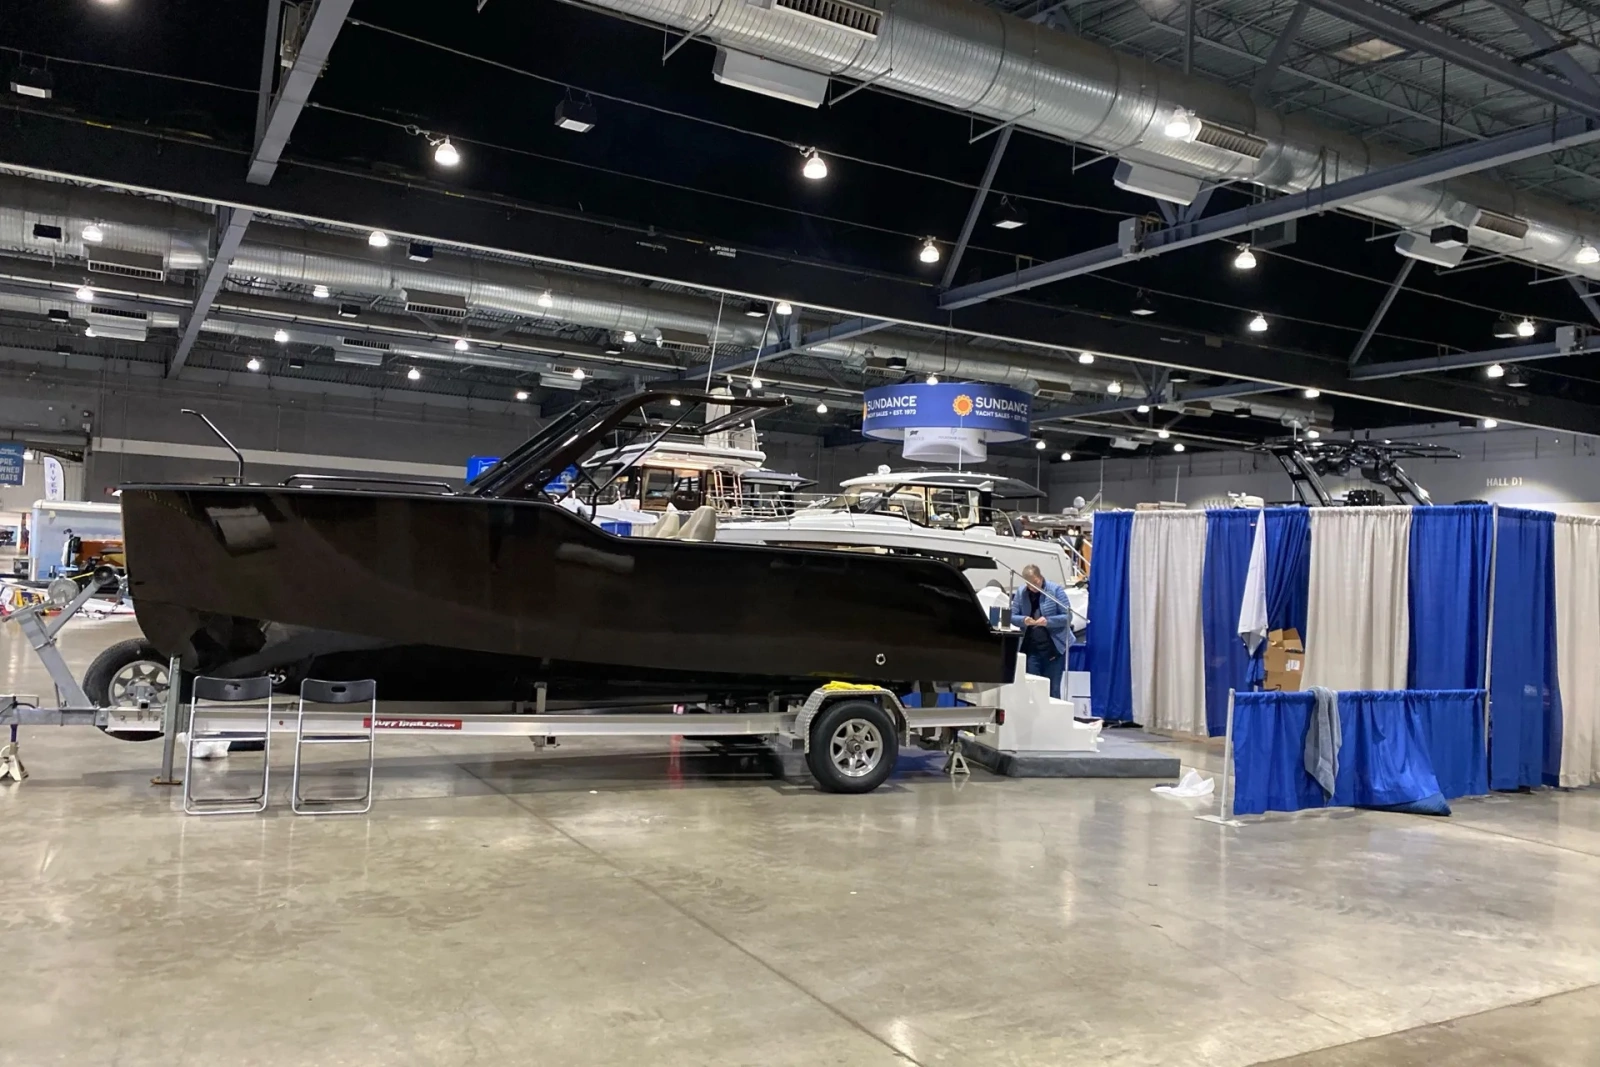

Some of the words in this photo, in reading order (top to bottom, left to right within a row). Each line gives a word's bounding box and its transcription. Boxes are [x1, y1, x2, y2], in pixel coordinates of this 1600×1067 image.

[868, 396, 917, 411] SUNDANCE
[975, 396, 1028, 415] SUNDANCE
[995, 411, 1010, 419] SALES
[0, 465, 20, 474] WNED
[0, 473, 18, 481] OATS
[49, 463, 58, 494] RIVER
[1486, 477, 1509, 487] HALL
[1511, 476, 1523, 486] D1
